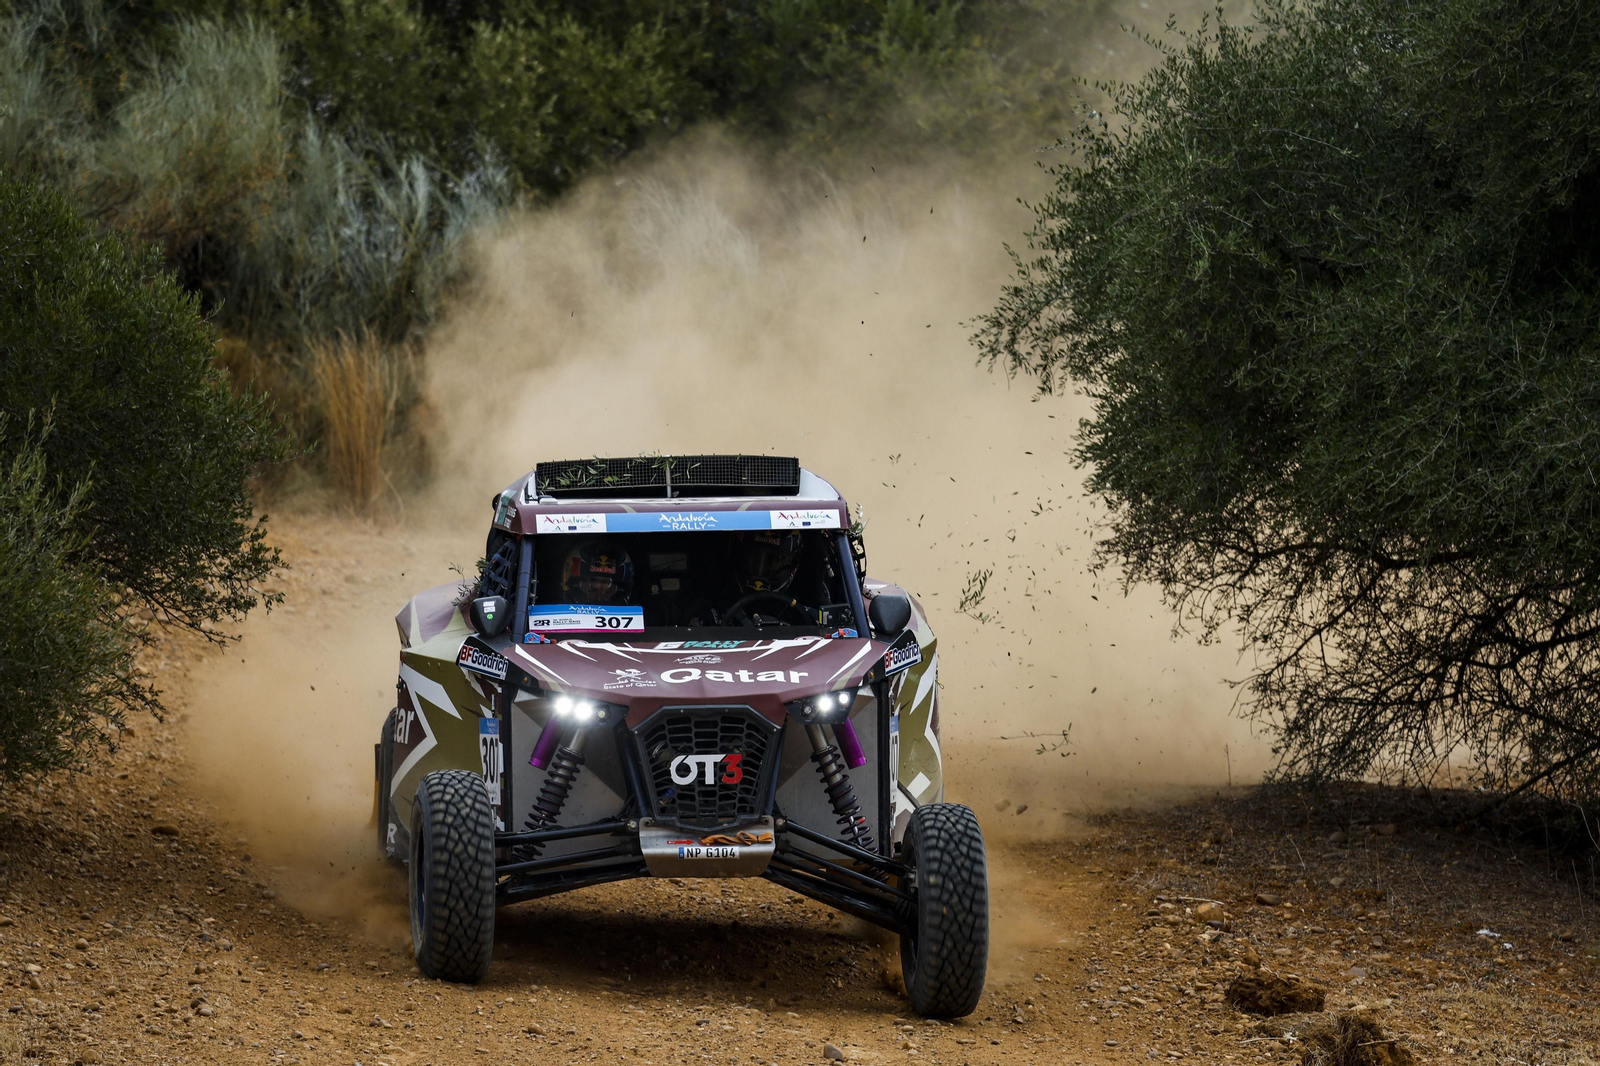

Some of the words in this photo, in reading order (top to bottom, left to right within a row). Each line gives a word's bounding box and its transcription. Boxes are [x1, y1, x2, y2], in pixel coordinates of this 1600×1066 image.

[659, 512, 718, 523] Andalucía
[672, 522, 707, 530] RALLY
[595, 616, 634, 629] 307
[460, 644, 509, 673] BFGoodrich
[660, 667, 809, 684] Qatar
[482, 737, 499, 784] 307
[670, 753, 744, 785] OT3
[686, 847, 701, 859] NP
